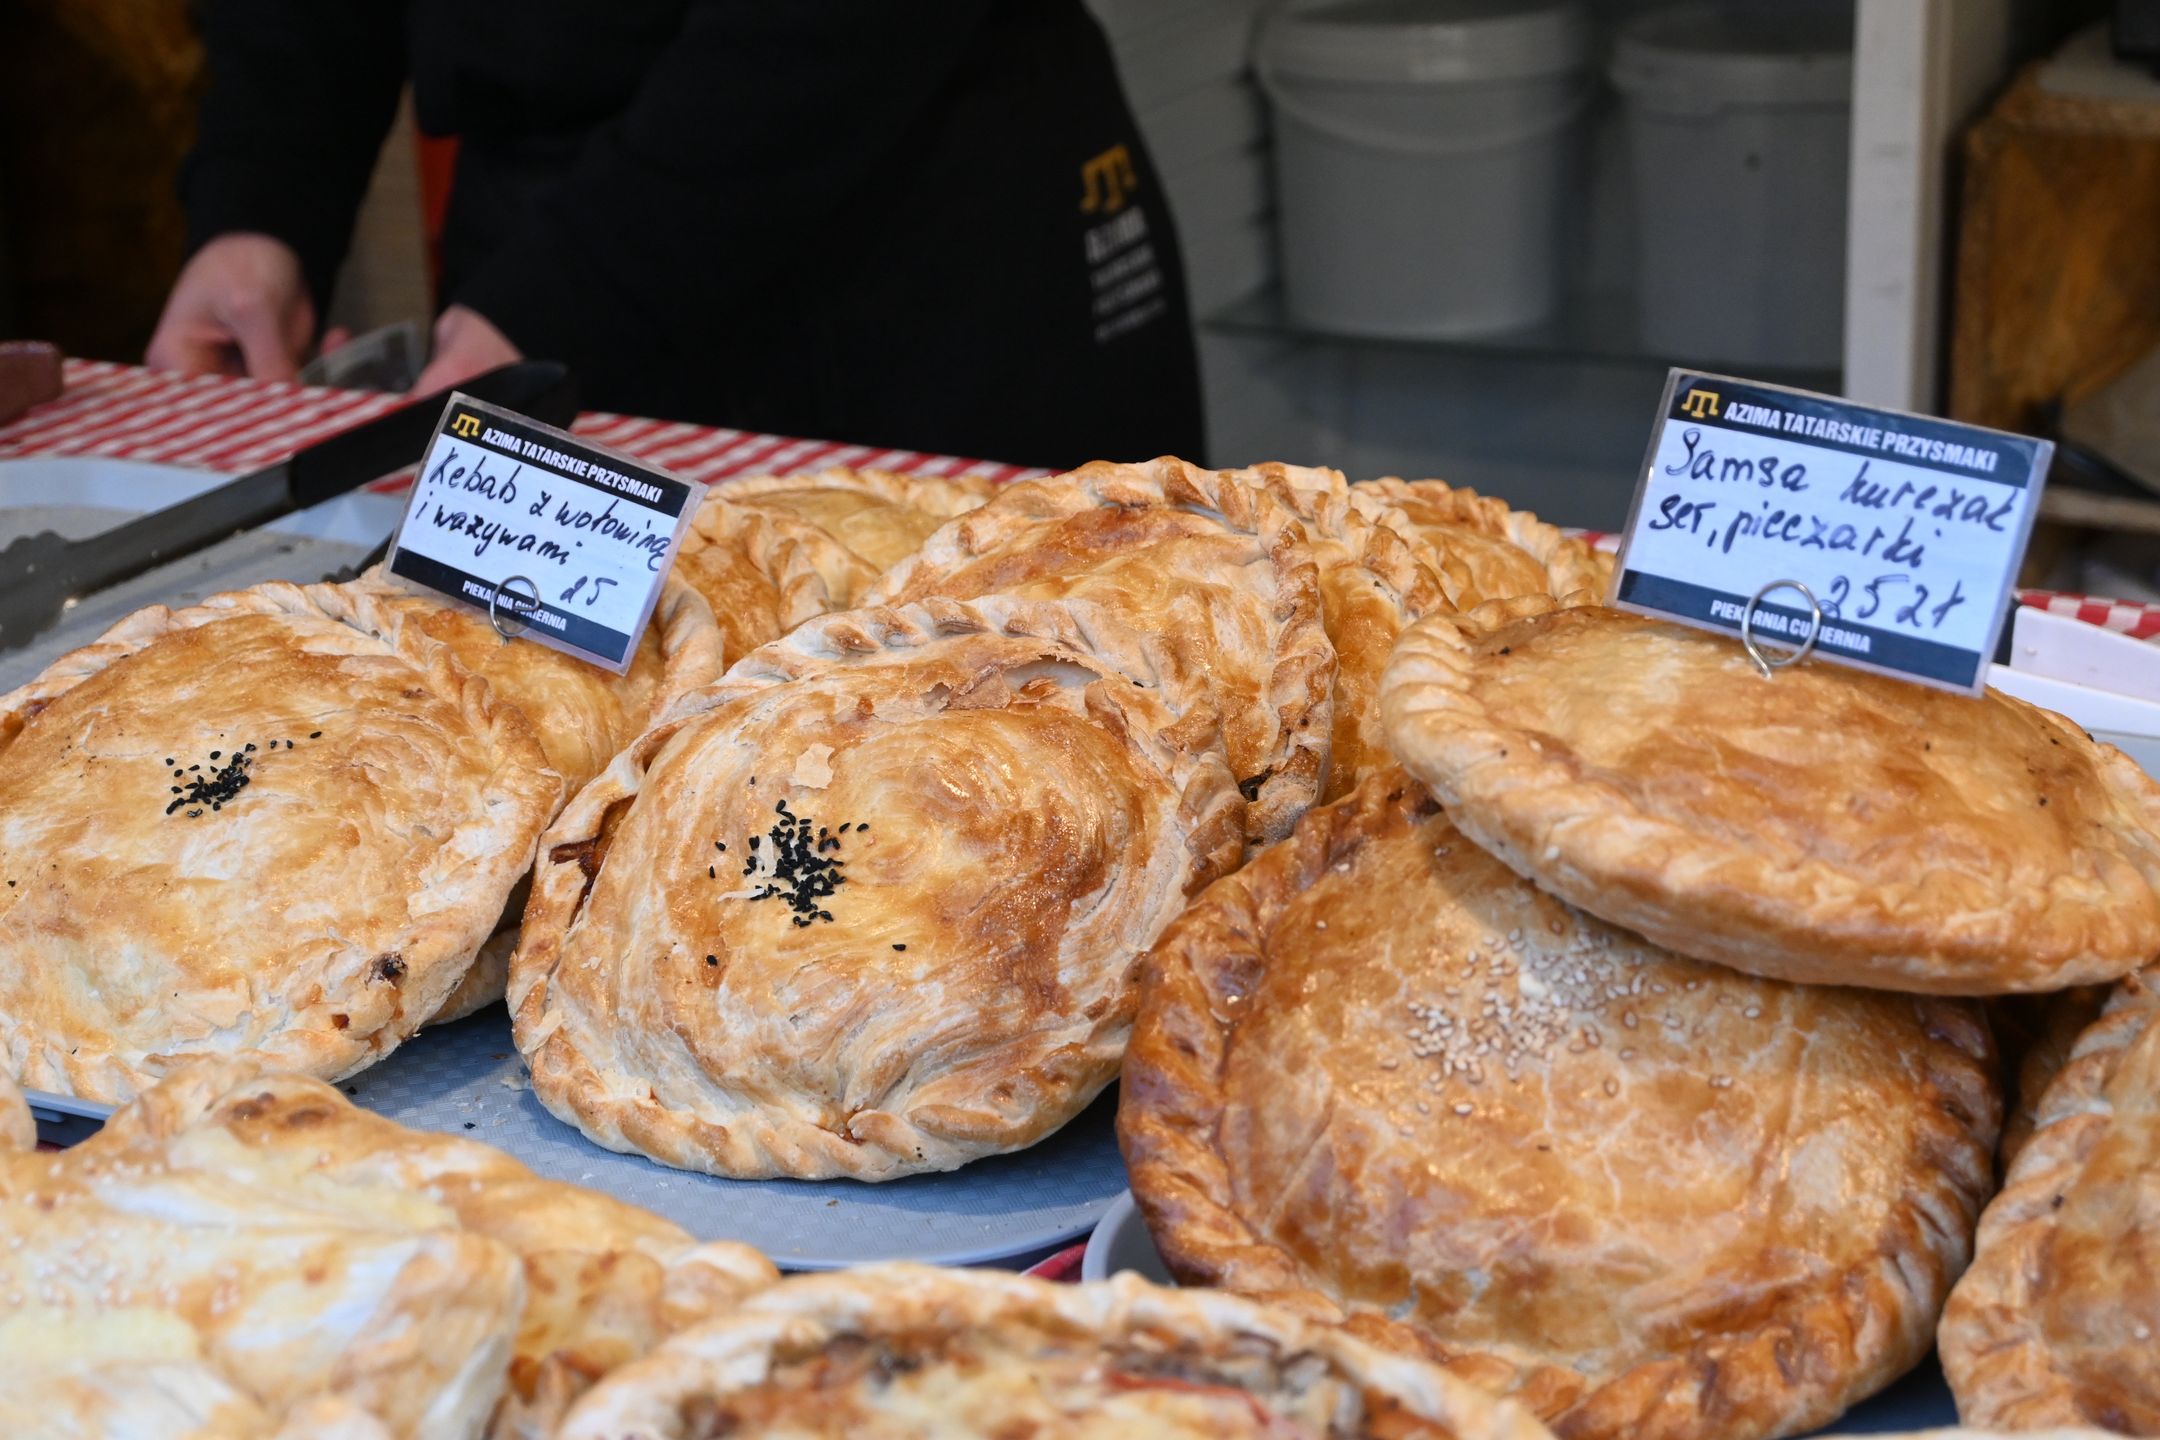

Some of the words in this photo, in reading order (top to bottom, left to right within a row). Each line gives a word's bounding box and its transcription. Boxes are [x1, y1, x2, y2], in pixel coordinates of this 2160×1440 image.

[482, 427, 522, 452] AZIMA
[521, 440, 587, 476] TATARSKIE
[586, 456, 663, 503] PRZYSMAKI
[1665, 427, 1811, 492] Samsa
[1724, 401, 1782, 430] AZIMA
[1783, 413, 1880, 450] TATARSKIE
[1885, 431, 1999, 472] PRZYSMAKI
[417, 491, 433, 520] i
[554, 497, 672, 572] wołowiną
[462, 580, 514, 610] PIEKANIA
[560, 575, 619, 607] 25
[1710, 599, 1788, 633] PIEKRNIA
[1789, 618, 1871, 653] CUIERNIA
